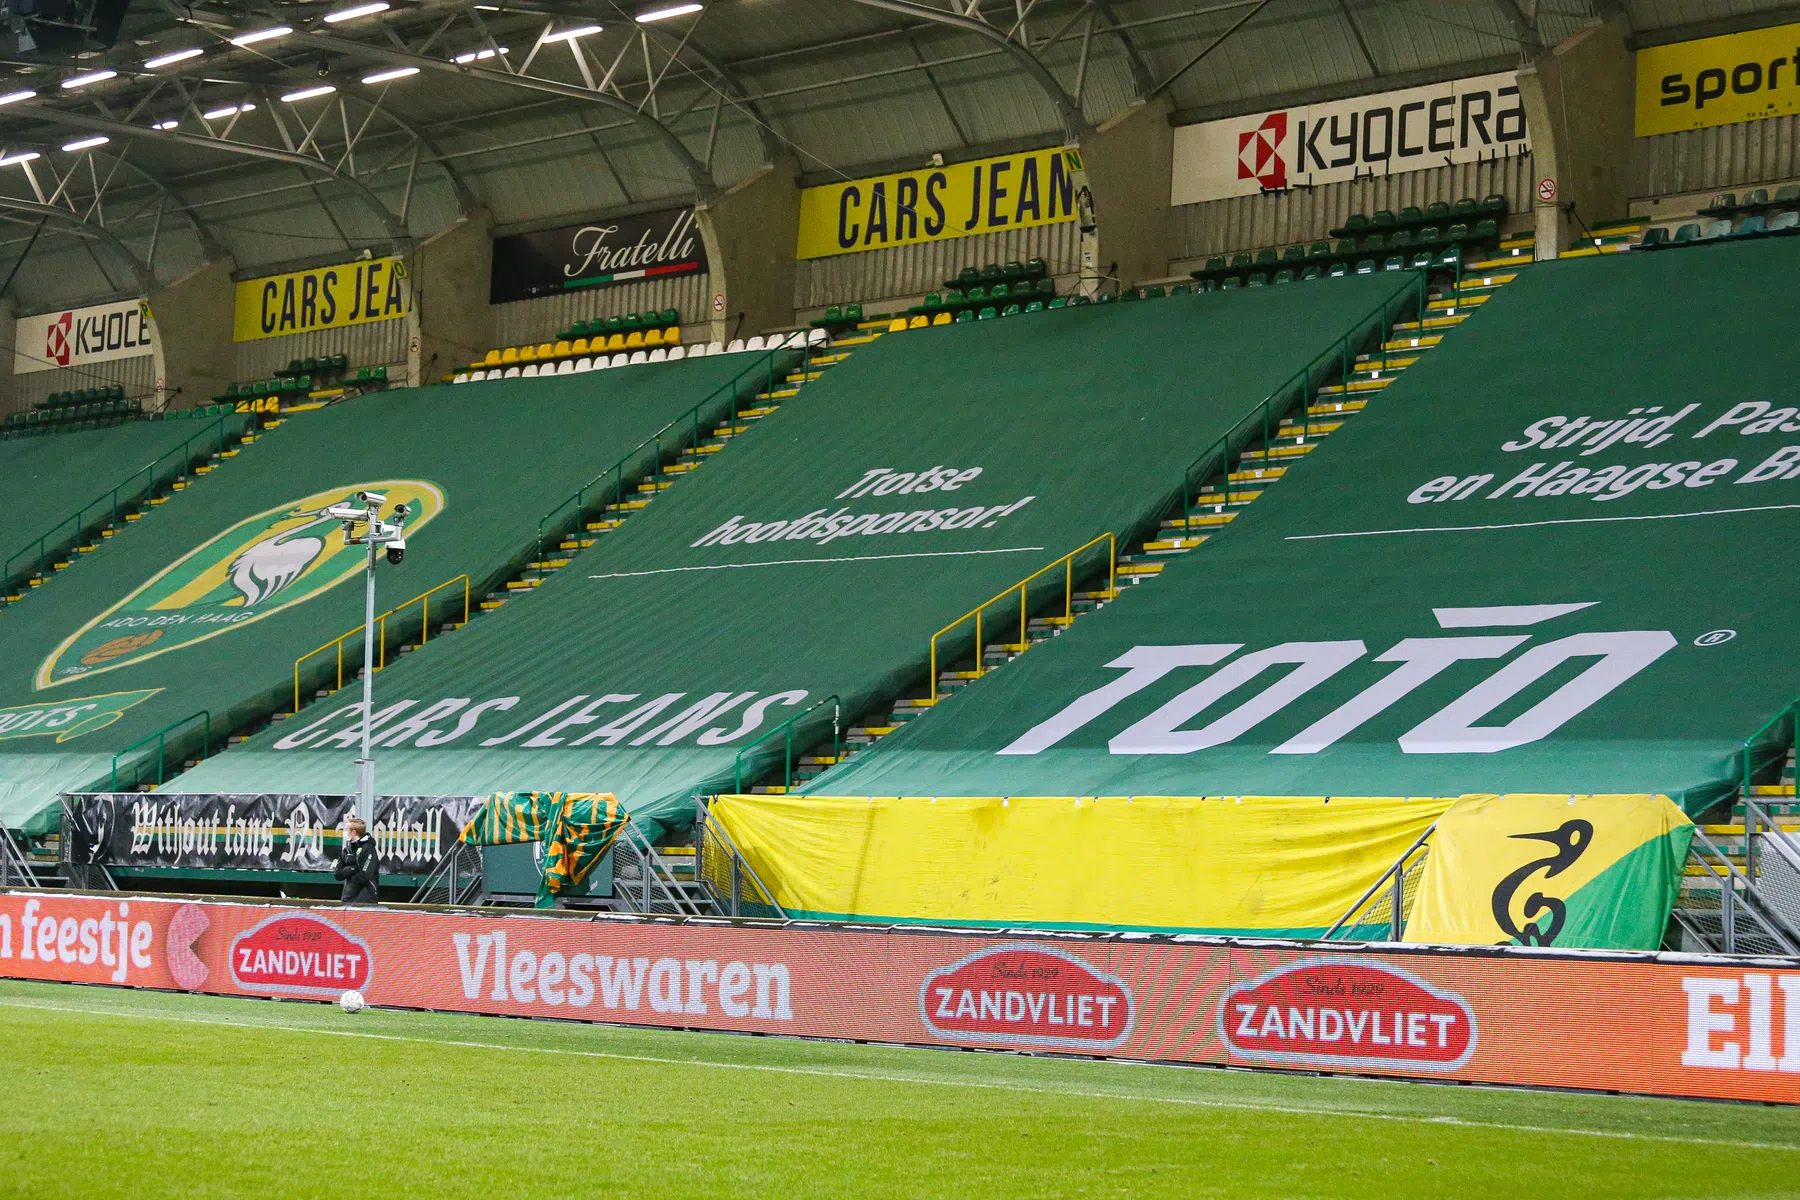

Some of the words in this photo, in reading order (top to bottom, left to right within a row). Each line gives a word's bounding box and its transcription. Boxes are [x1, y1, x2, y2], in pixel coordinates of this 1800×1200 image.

[1067, 151, 1082, 171] N
[838, 171, 946, 248] CARS
[964, 152, 1074, 231] JEAN
[564, 210, 700, 277] Fratelli
[141, 303, 150, 317] P
[261, 271, 338, 334] CARS
[1501, 404, 1702, 456] Strijd,
[835, 465, 983, 500] Trotse
[1406, 474, 1494, 504] en
[1486, 459, 1738, 501] Haagse
[690, 496, 1036, 548] hoofdsponsor!
[100, 617, 149, 629] ADO
[148, 614, 192, 627] DEN
[192, 611, 254, 624] HAAG
[995, 602, 1679, 755] TOTO
[272, 696, 521, 750] CARS
[478, 689, 809, 748] JEANS
[130, 798, 220, 864] Without
[225, 804, 275, 858] fans
[280, 801, 324, 863] No
[331, 803, 443, 869] otball
[21, 899, 153, 982] feestje
[239, 948, 361, 979] ZANDVLIET
[453, 930, 793, 1021] Vleeswaren
[935, 987, 1118, 1028] ZANDVLIET
[1235, 1003, 1456, 1048] ZANDVLIET
